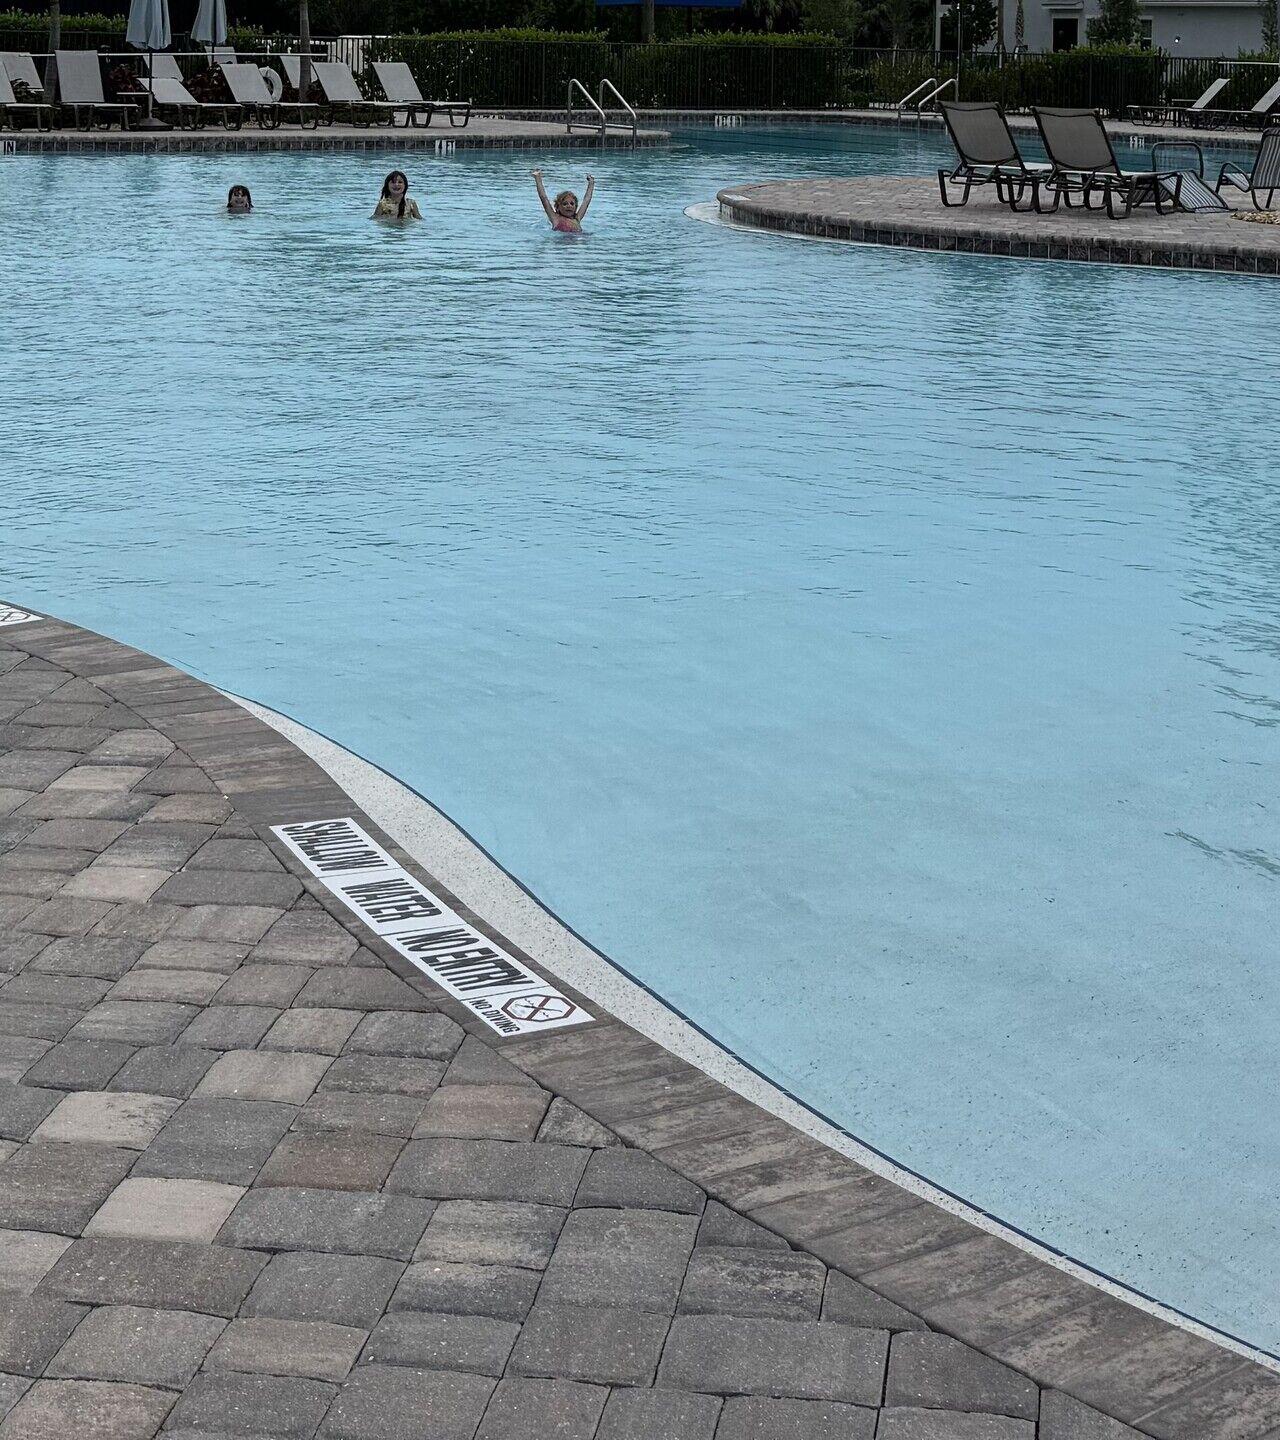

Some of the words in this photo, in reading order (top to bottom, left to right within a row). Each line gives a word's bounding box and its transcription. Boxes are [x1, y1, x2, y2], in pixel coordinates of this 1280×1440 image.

[3, 140, 15, 154] IN
[281, 820, 389, 872] SHALLOW
[340, 877, 443, 924] WATER
[396, 928, 480, 952] NO
[420, 947, 535, 992] ENTRY
[468, 998, 493, 1010] NO
[481, 1009, 521, 1034] DIVING
